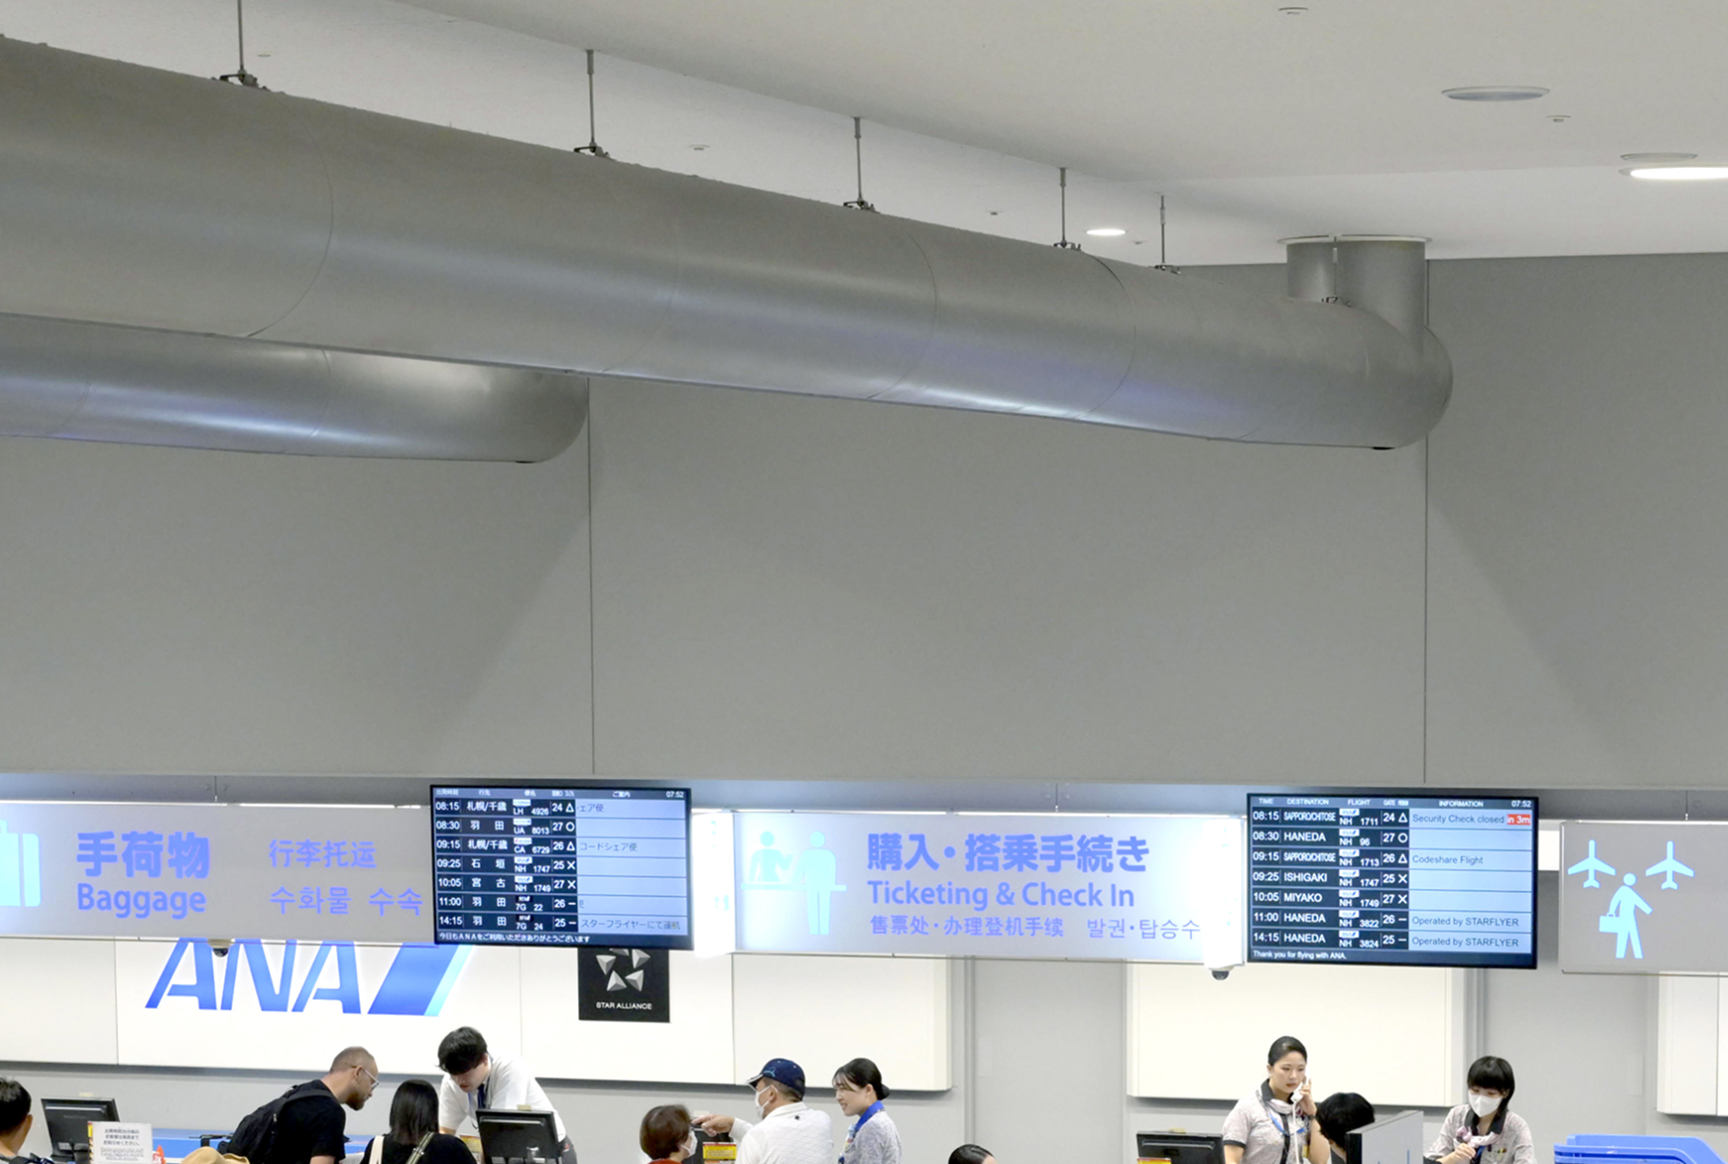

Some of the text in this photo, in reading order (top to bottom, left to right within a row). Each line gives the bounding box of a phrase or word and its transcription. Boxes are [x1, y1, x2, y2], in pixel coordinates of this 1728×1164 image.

[436, 802, 460, 811] 08:15
[467, 802, 507, 812] 札幌/千歳
[513, 808, 524, 816] LH
[552, 803, 563, 812] 24
[1439, 800, 1484, 808] INFORMATION
[1511, 800, 1532, 808] 07:52
[1253, 811, 1279, 820] 08:15
[1340, 818, 1352, 826] NH
[1360, 818, 1378, 826] 1711
[1383, 812, 1396, 822] 24
[1412, 814, 1446, 824] Security
[1448, 814, 1475, 823] Check
[1477, 814, 1504, 824] closed
[436, 820, 460, 830] 08:30
[514, 827, 525, 835] UA
[552, 822, 564, 832] 27
[1253, 831, 1279, 840] 08:30
[1284, 832, 1326, 842] HANEDA
[1340, 838, 1352, 846] NH
[1383, 833, 1396, 842] 27
[268, 838, 377, 869] 行李托运
[436, 840, 460, 849] 09:15
[468, 840, 508, 850] 札幌/千歳
[514, 846, 526, 854] CA
[553, 842, 564, 850] 26
[579, 842, 638, 852] コードシェア便
[867, 832, 1149, 873] 購入・搭乗手続き
[76, 831, 210, 879] 手荷物
[1253, 852, 1279, 861] 09:15
[1340, 858, 1352, 866] NH
[1360, 858, 1380, 866] 1713
[1383, 854, 1396, 862] 26
[1412, 855, 1458, 864] Codeshare
[1460, 856, 1483, 865] Flight
[437, 859, 461, 868] 09:25
[514, 865, 526, 873] NH
[534, 865, 550, 873] 1747
[553, 860, 565, 870] 25
[1253, 872, 1396, 886] 09:25 ISHIGAKI NH 1747 25
[77, 882, 207, 920] Baggage
[269, 886, 424, 916] 수화물 수속
[867, 880, 1135, 912] Ticketing & Check In
[1254, 892, 1396, 907] 10:05 MIYAKO NH 1749 27
[439, 916, 463, 926] 14:15
[516, 922, 528, 931] 7G
[534, 922, 544, 931] 24
[554, 918, 566, 928] 25
[1254, 912, 1519, 928] 11:00 HANEDA NH 3822 26 Operated by STARFLYER
[1254, 933, 1519, 948] 14:15 HANEDA NH 3824 25 Operated by STARFLYER
[1253, 950, 1273, 958] Thank
[1297, 951, 1314, 960] flying
[1316, 951, 1328, 959] with
[145, 937, 361, 1014] ANA
[596, 1001, 653, 1010] STAR ALLIANCE
